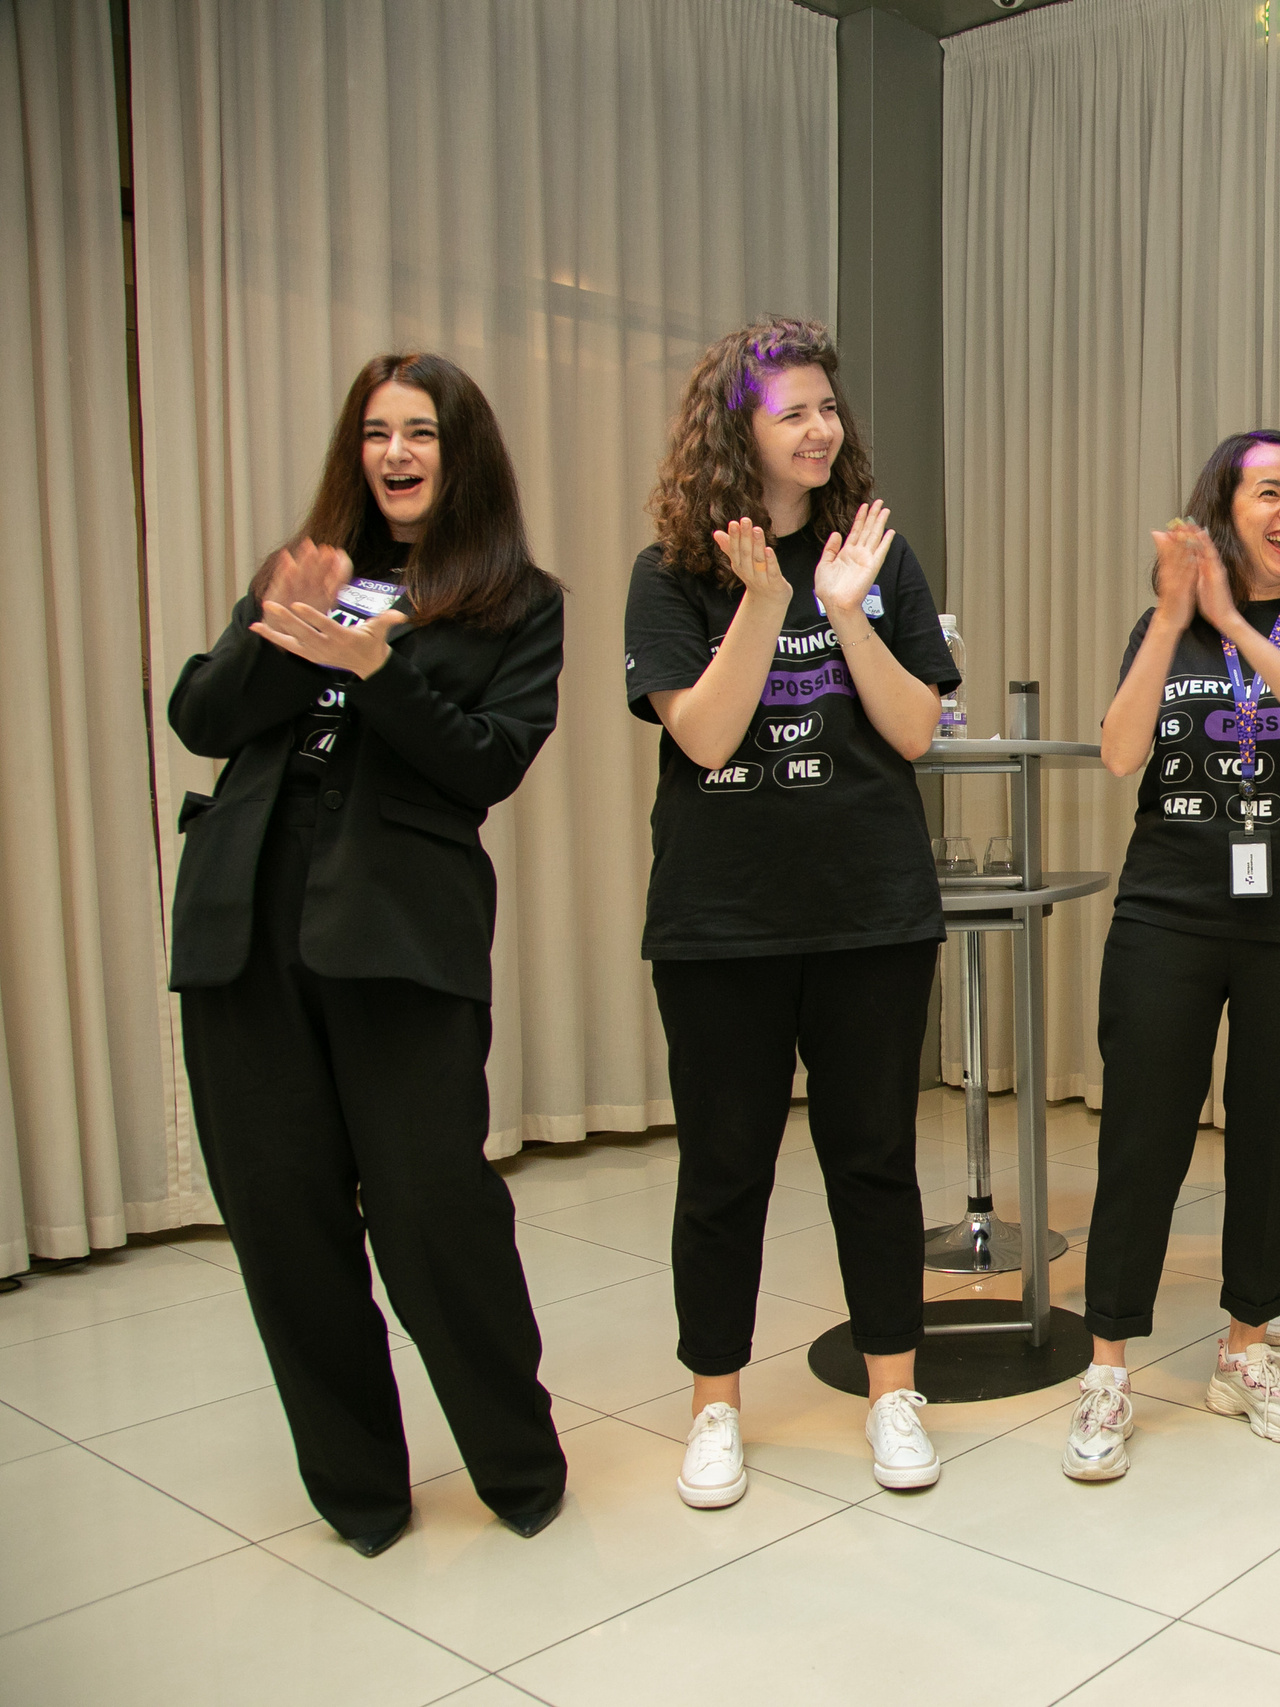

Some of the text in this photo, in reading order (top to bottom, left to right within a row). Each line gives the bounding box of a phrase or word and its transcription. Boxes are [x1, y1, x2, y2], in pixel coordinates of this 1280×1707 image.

[358, 580, 398, 593] ХЭЛОУ
[770, 668, 854, 697] POSSIBL
[769, 718, 813, 743] YOU
[1160, 718, 1181, 737] IS
[705, 758, 821, 784] ARE ME
[1165, 758, 1181, 776] IF
[1163, 797, 1273, 817] ARE ME
